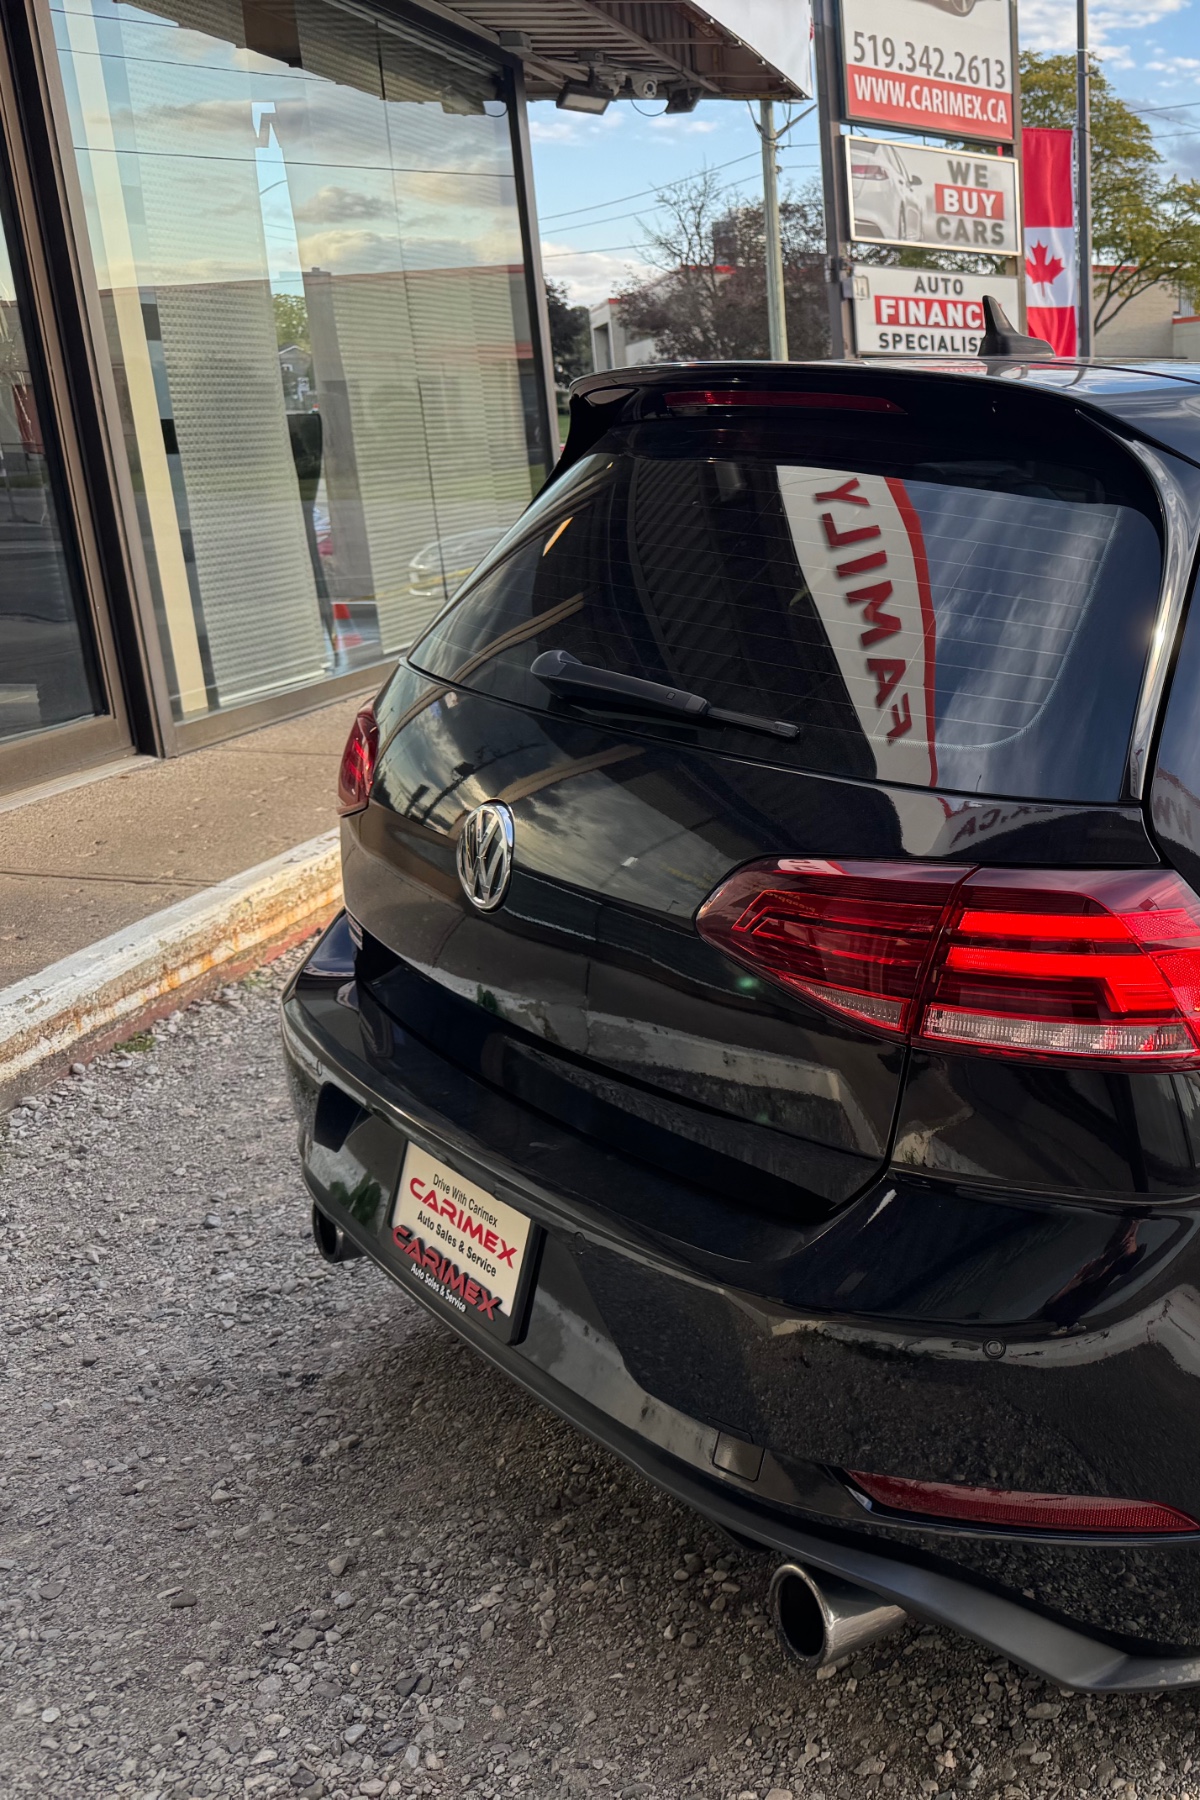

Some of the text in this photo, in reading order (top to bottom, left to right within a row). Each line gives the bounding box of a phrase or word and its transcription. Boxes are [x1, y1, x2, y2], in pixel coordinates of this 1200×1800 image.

[853, 30, 1005, 89] 519.342.2613
[853, 73, 1008, 124] WWW.CARIMEX.CA
[947, 160, 988, 188] WE
[943, 188, 997, 217] BUY
[935, 216, 1005, 245] CARS
[914, 276, 964, 296] AUTO
[879, 299, 985, 328] FINANC
[409, 1177, 518, 1269] CARIMEX
[433, 1173, 498, 1228] Drive With Carimex
[417, 1210, 497, 1277] Auto Sales & Service
[392, 1224, 502, 1321] CARIMEX
[410, 1263, 467, 1313] Auto Sales & Service
